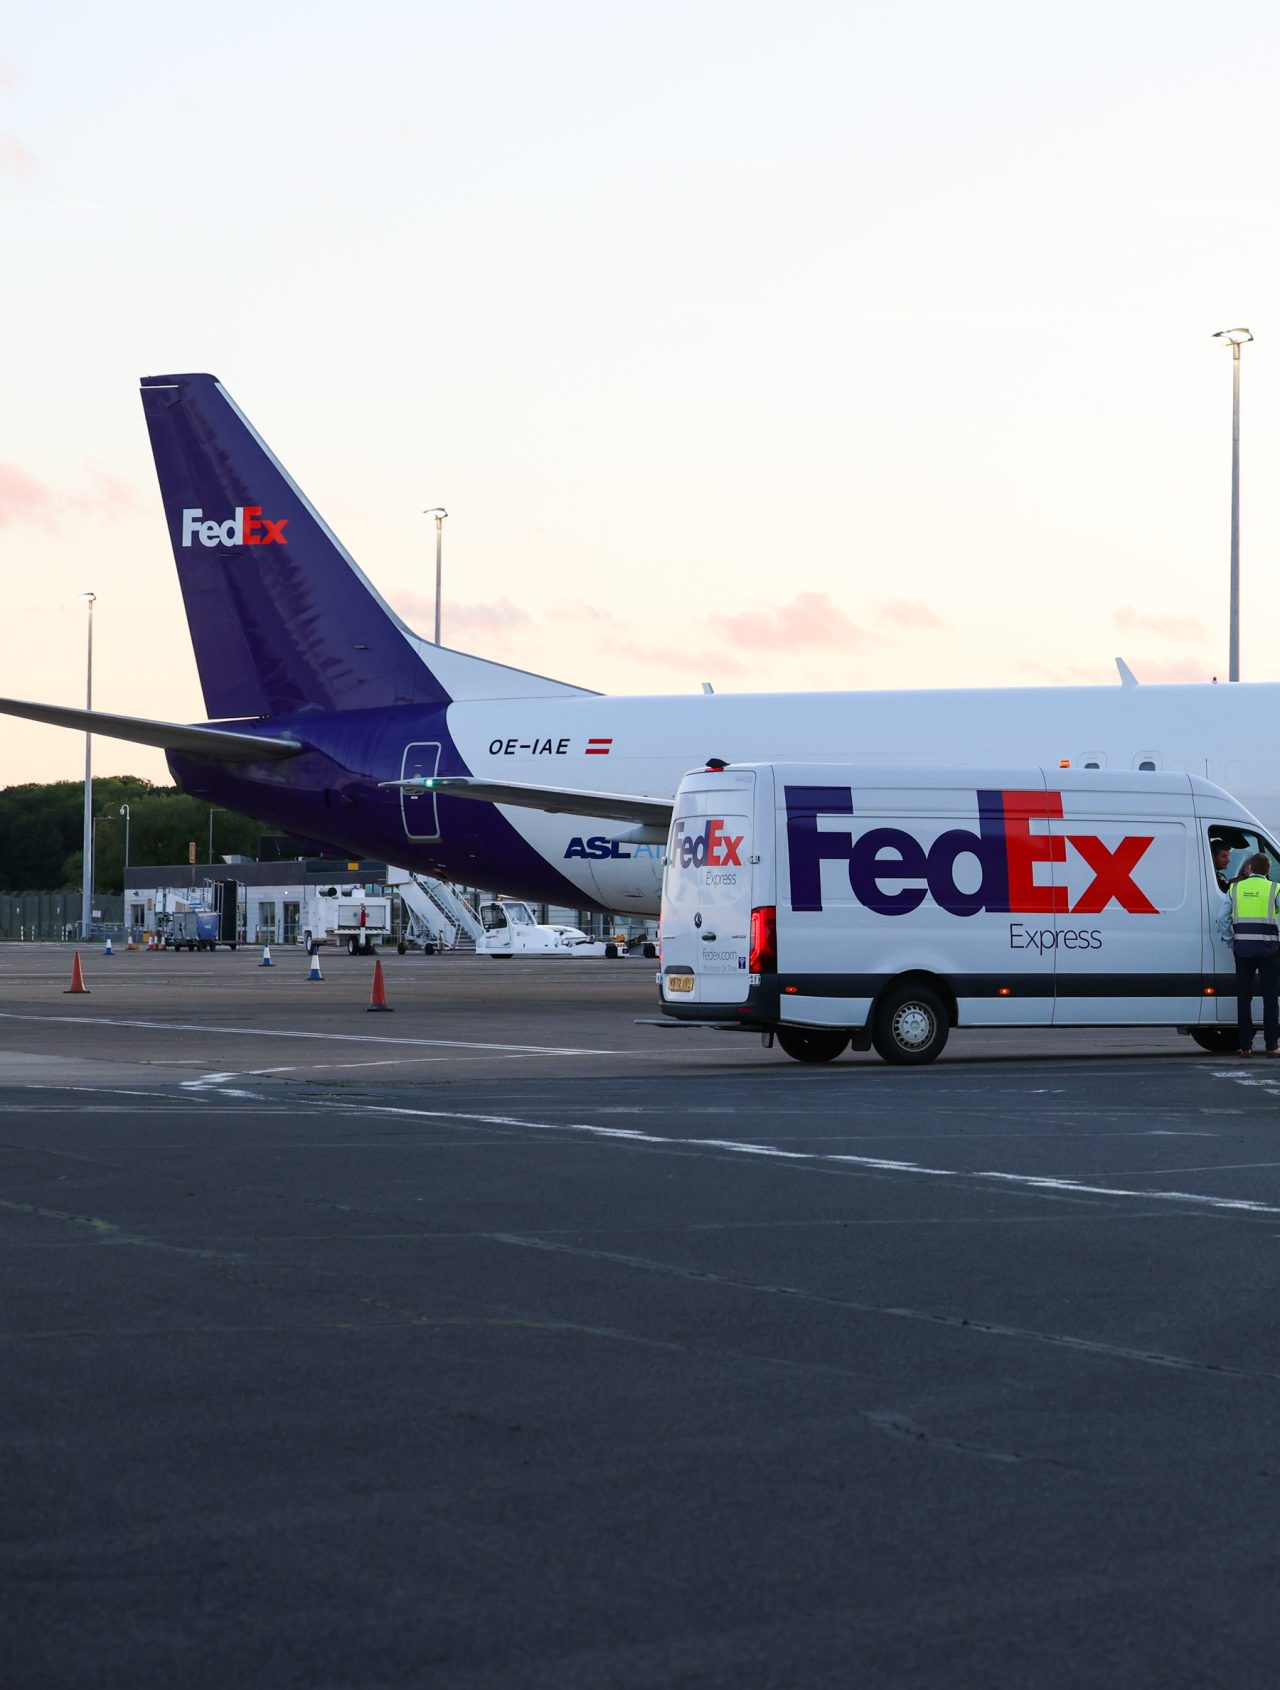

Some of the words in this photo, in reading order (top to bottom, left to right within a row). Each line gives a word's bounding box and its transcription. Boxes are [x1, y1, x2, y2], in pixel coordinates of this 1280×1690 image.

[182, 506, 289, 547] FedEx
[488, 738, 571, 755] OE-IAE
[563, 836, 631, 859] ASL
[671, 819, 745, 870] FedEx
[784, 785, 1161, 918] FedEx
[705, 871, 737, 888] Express
[702, 947, 737, 960] fedex.com
[1009, 923, 1103, 956] Express
